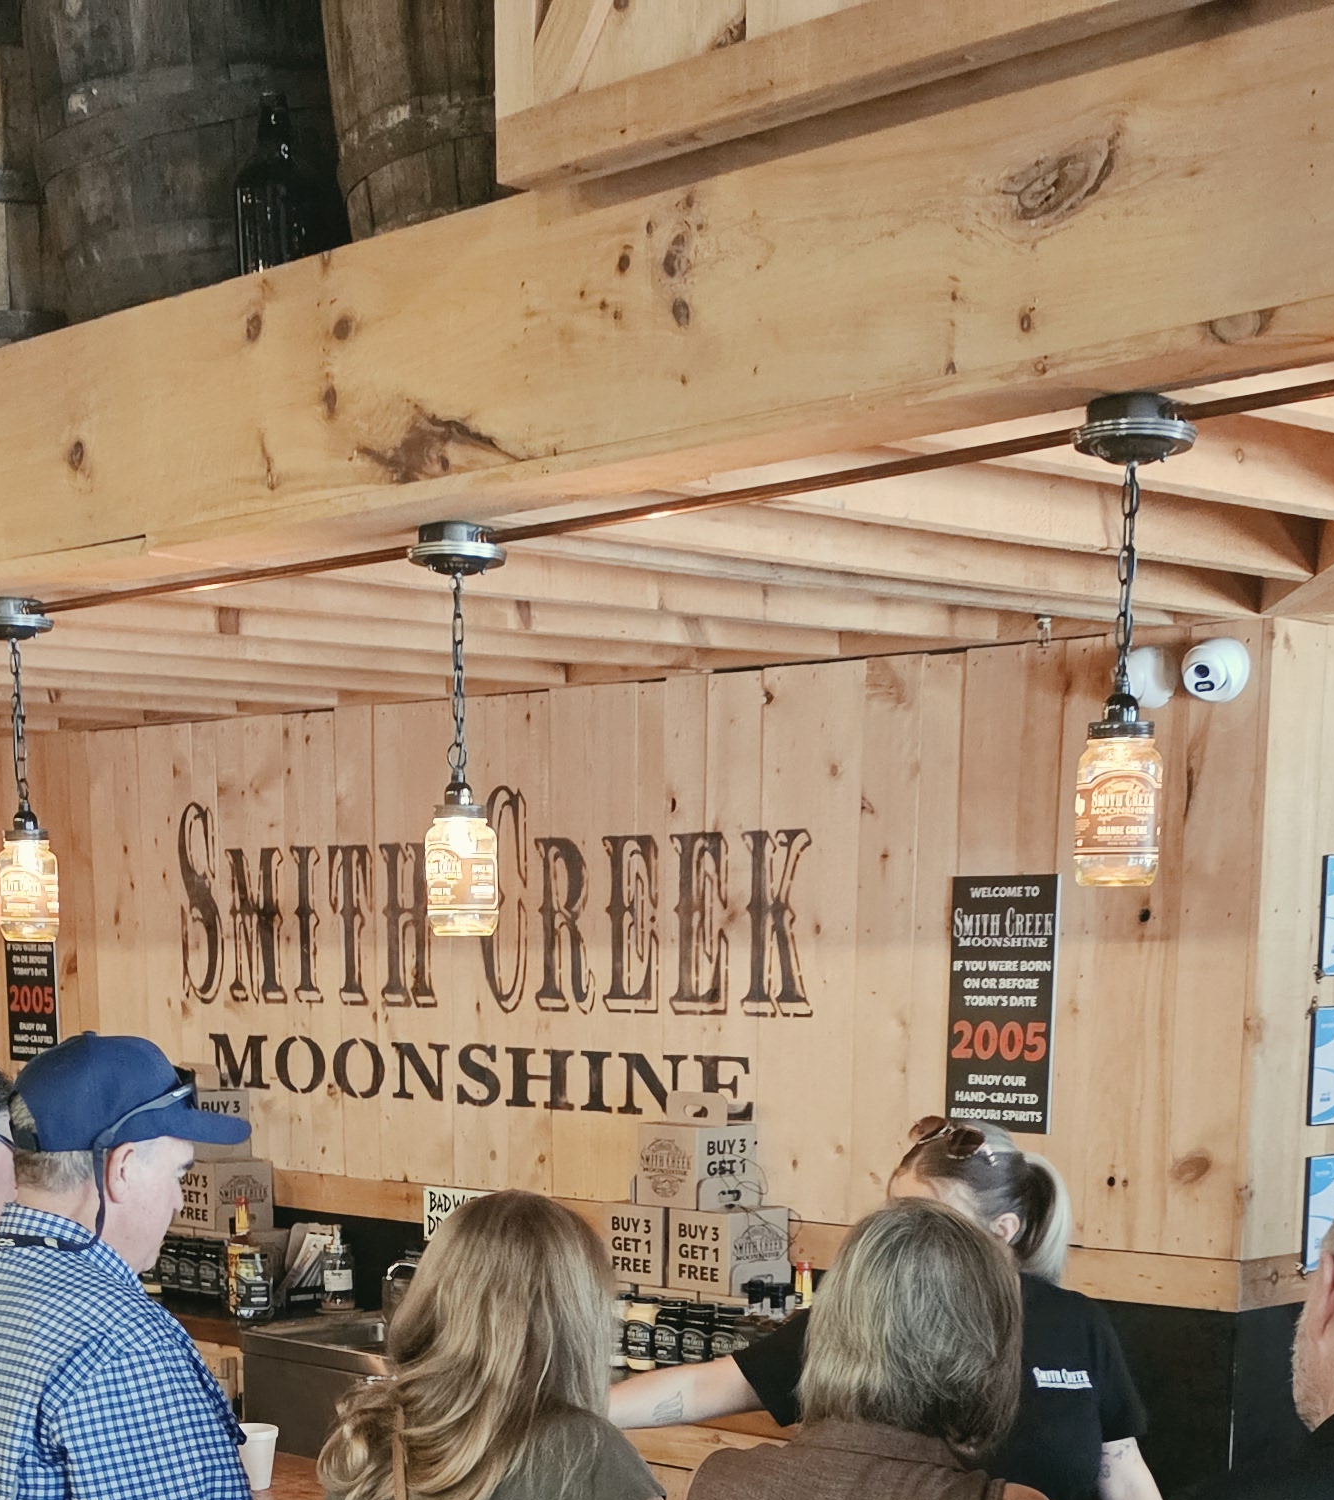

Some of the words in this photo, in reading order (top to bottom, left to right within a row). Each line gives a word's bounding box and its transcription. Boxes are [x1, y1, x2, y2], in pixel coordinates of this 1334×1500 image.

[970, 886, 1023, 898] WELCOME
[1024, 886, 1040, 897] TO
[178, 800, 439, 1008] SMITH
[479, 785, 813, 1018] CREEK
[953, 907, 1001, 938] SMITH
[1004, 906, 1054, 938] CREEK
[958, 936, 1048, 948] MOONSHINE
[952, 960, 963, 972] IF
[964, 960, 987, 972] YOU
[988, 960, 1019, 972] WERE
[1020, 960, 1052, 972] BORN
[963, 978, 981, 990] ON
[981, 978, 998, 990] OR
[998, 978, 1039, 990] BEFORE
[9, 984, 55, 1015] 2005
[963, 995, 1008, 1008] TODAY'S
[1009, 995, 1038, 1008] DATE
[950, 1020, 1047, 1062] 2005
[209, 1031, 754, 1121] MOONSHINE
[968, 1073, 1001, 1087] ENJOY
[1002, 1074, 1027, 1088] OUR
[200, 1101, 230, 1114] BUY
[232, 1100, 241, 1114] 3
[954, 1091, 1039, 1105] HAND-CRAFTED
[950, 1107, 1001, 1121] MISSOURI
[1002, 1110, 1043, 1123] SPIRITS
[707, 1139, 736, 1156] BUY
[738, 1138, 747, 1154] 3
[707, 1159, 737, 1176] GET
[740, 1158, 746, 1174] 1
[179, 1172, 200, 1187] BUY
[202, 1175, 209, 1188] 3
[181, 1190, 200, 1204] GET
[204, 1193, 209, 1205] 1
[428, 1191, 452, 1213] BAD
[180, 1207, 209, 1222] FREE
[611, 1215, 640, 1233] BUY
[643, 1219, 652, 1234] 3
[678, 1223, 709, 1241] BUY
[711, 1227, 720, 1242] 3
[611, 1236, 642, 1253] GET
[644, 1240, 651, 1255] 1
[678, 1243, 710, 1261] GET
[712, 1248, 719, 1263] 1
[611, 1256, 652, 1274] FREE
[678, 1263, 720, 1283] FREE
